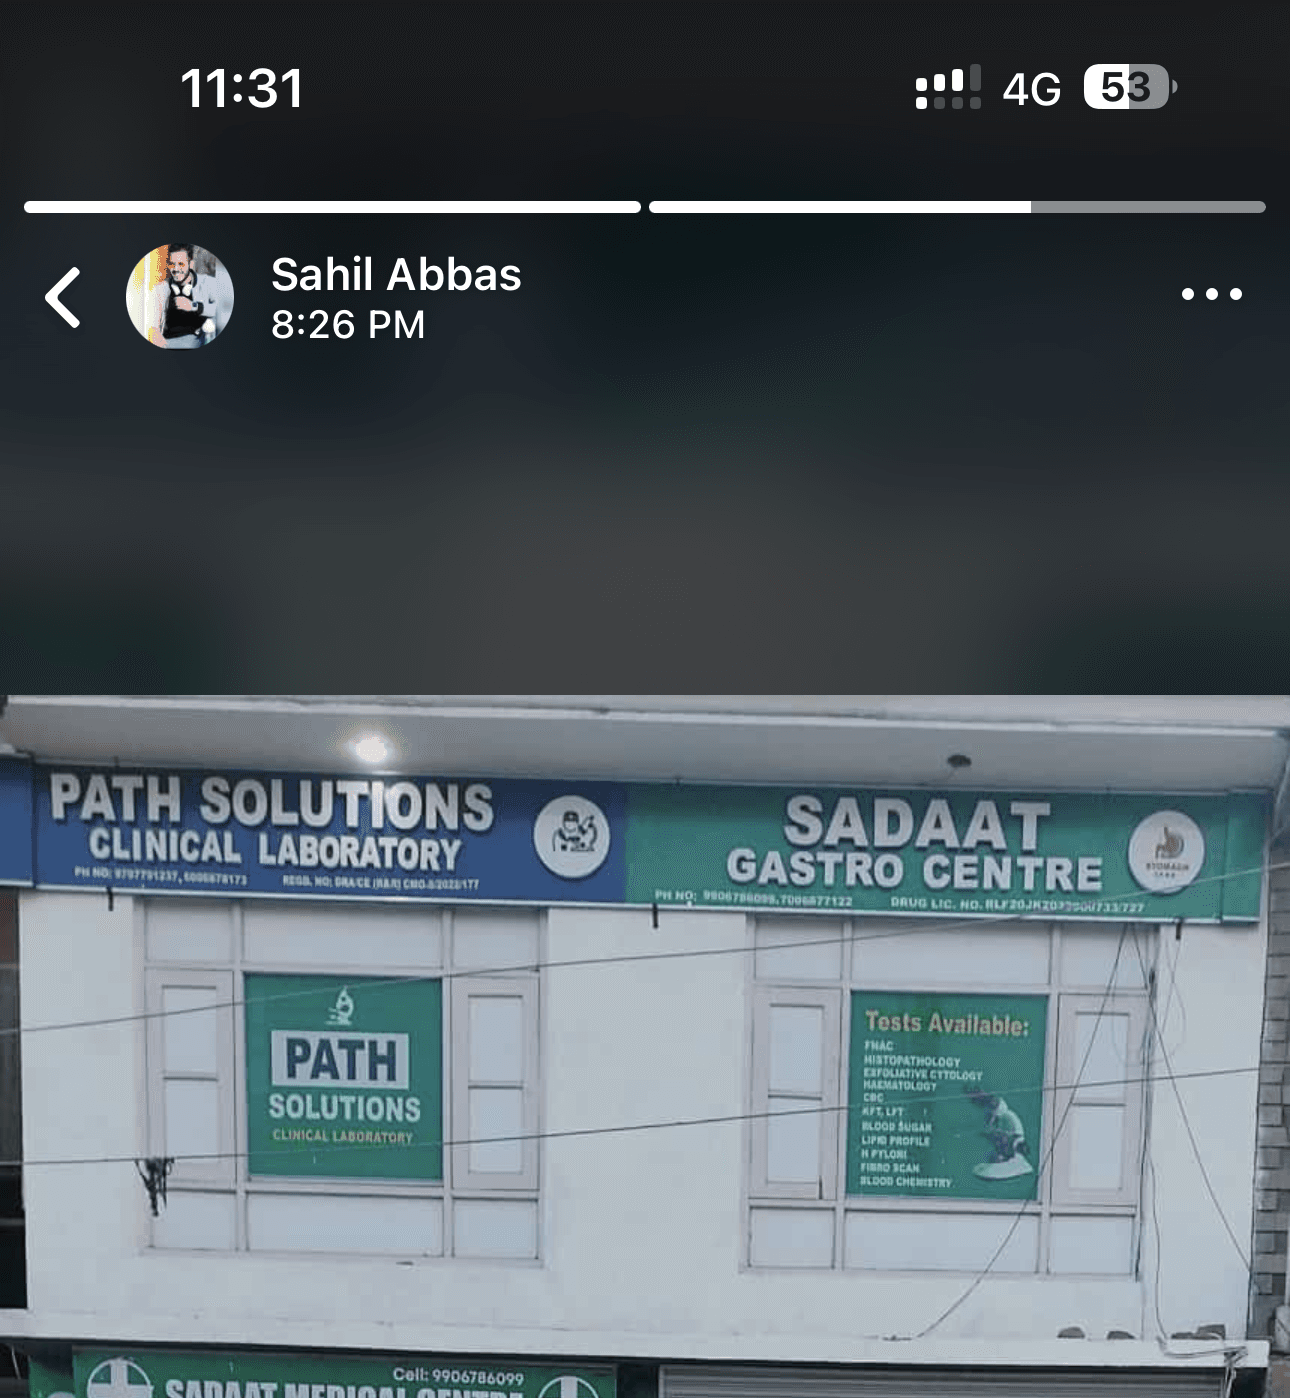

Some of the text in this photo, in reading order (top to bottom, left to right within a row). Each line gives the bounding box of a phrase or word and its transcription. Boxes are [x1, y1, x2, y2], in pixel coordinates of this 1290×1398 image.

[50, 774, 495, 831] PATH SOLUTIONS
[783, 796, 1051, 850] SADAAT
[89, 827, 463, 872] CLINICAL LABORATORY
[74, 866, 90, 877] PH
[726, 848, 1103, 891] GASTRO CENTRE
[655, 889, 673, 900] PH
[675, 890, 697, 902] NO:
[890, 896, 927, 909] DRUG
[931, 899, 956, 910] LIC.
[960, 900, 983, 911] NO.
[865, 1010, 1029, 1037] Tests Available:
[864, 1039, 895, 1051] FNAC
[286, 1037, 397, 1082] PATH
[863, 1055, 960, 1068] HISTOPATHOLOGY
[930, 1070, 983, 1081] CYTOLOGY
[863, 1080, 937, 1092] HAEMATOLOGY
[269, 1093, 421, 1122] SOLUTIONS
[862, 1121, 932, 1133] BLOOD SUGAR
[273, 1128, 413, 1144] CLINICAL LABORATORY
[862, 1135, 930, 1147] LIPID PROFILE
[861, 1149, 907, 1160] H PYLORI
[860, 1162, 920, 1173] FIBRO SCAN
[860, 1176, 953, 1189] BLOOD CHEMISTRY
[393, 1366, 524, 1387] Cell: 9906786099
